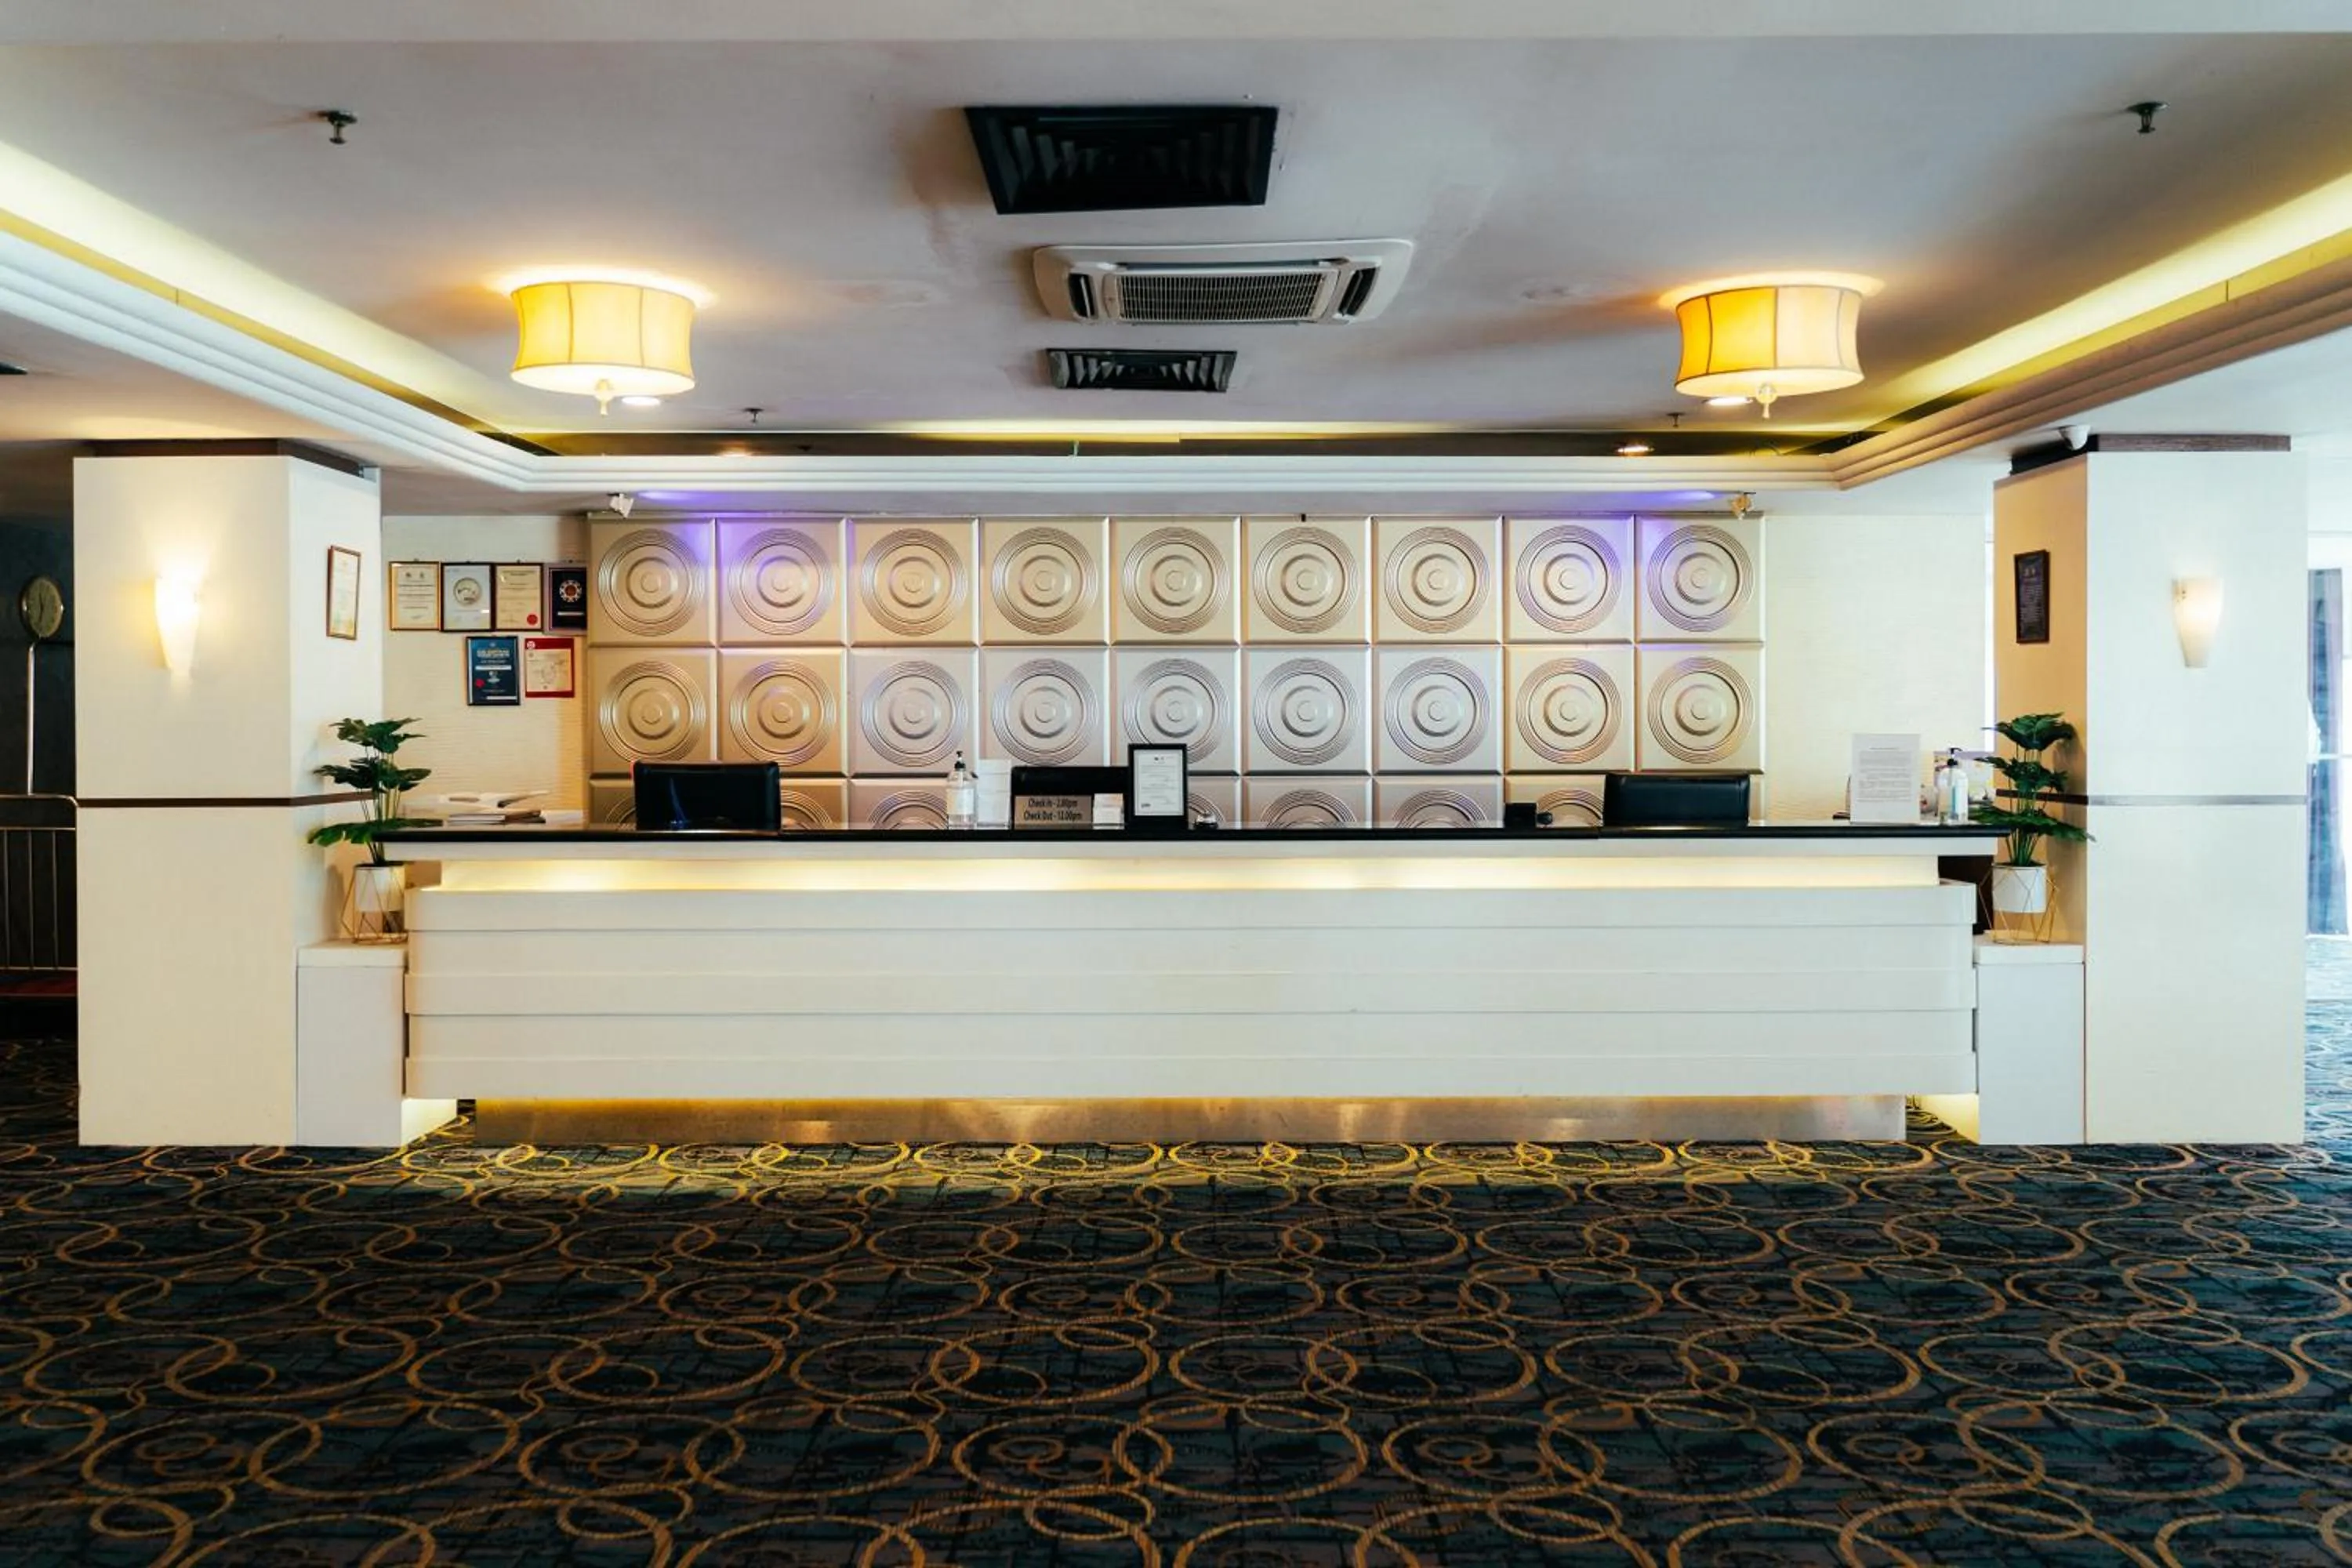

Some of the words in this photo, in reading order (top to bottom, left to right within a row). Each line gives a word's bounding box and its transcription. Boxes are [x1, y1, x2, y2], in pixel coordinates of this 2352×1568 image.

[1028, 798, 1046, 808] Check
[1023, 811, 1042, 820] Check
[1043, 811, 1052, 820] Out
